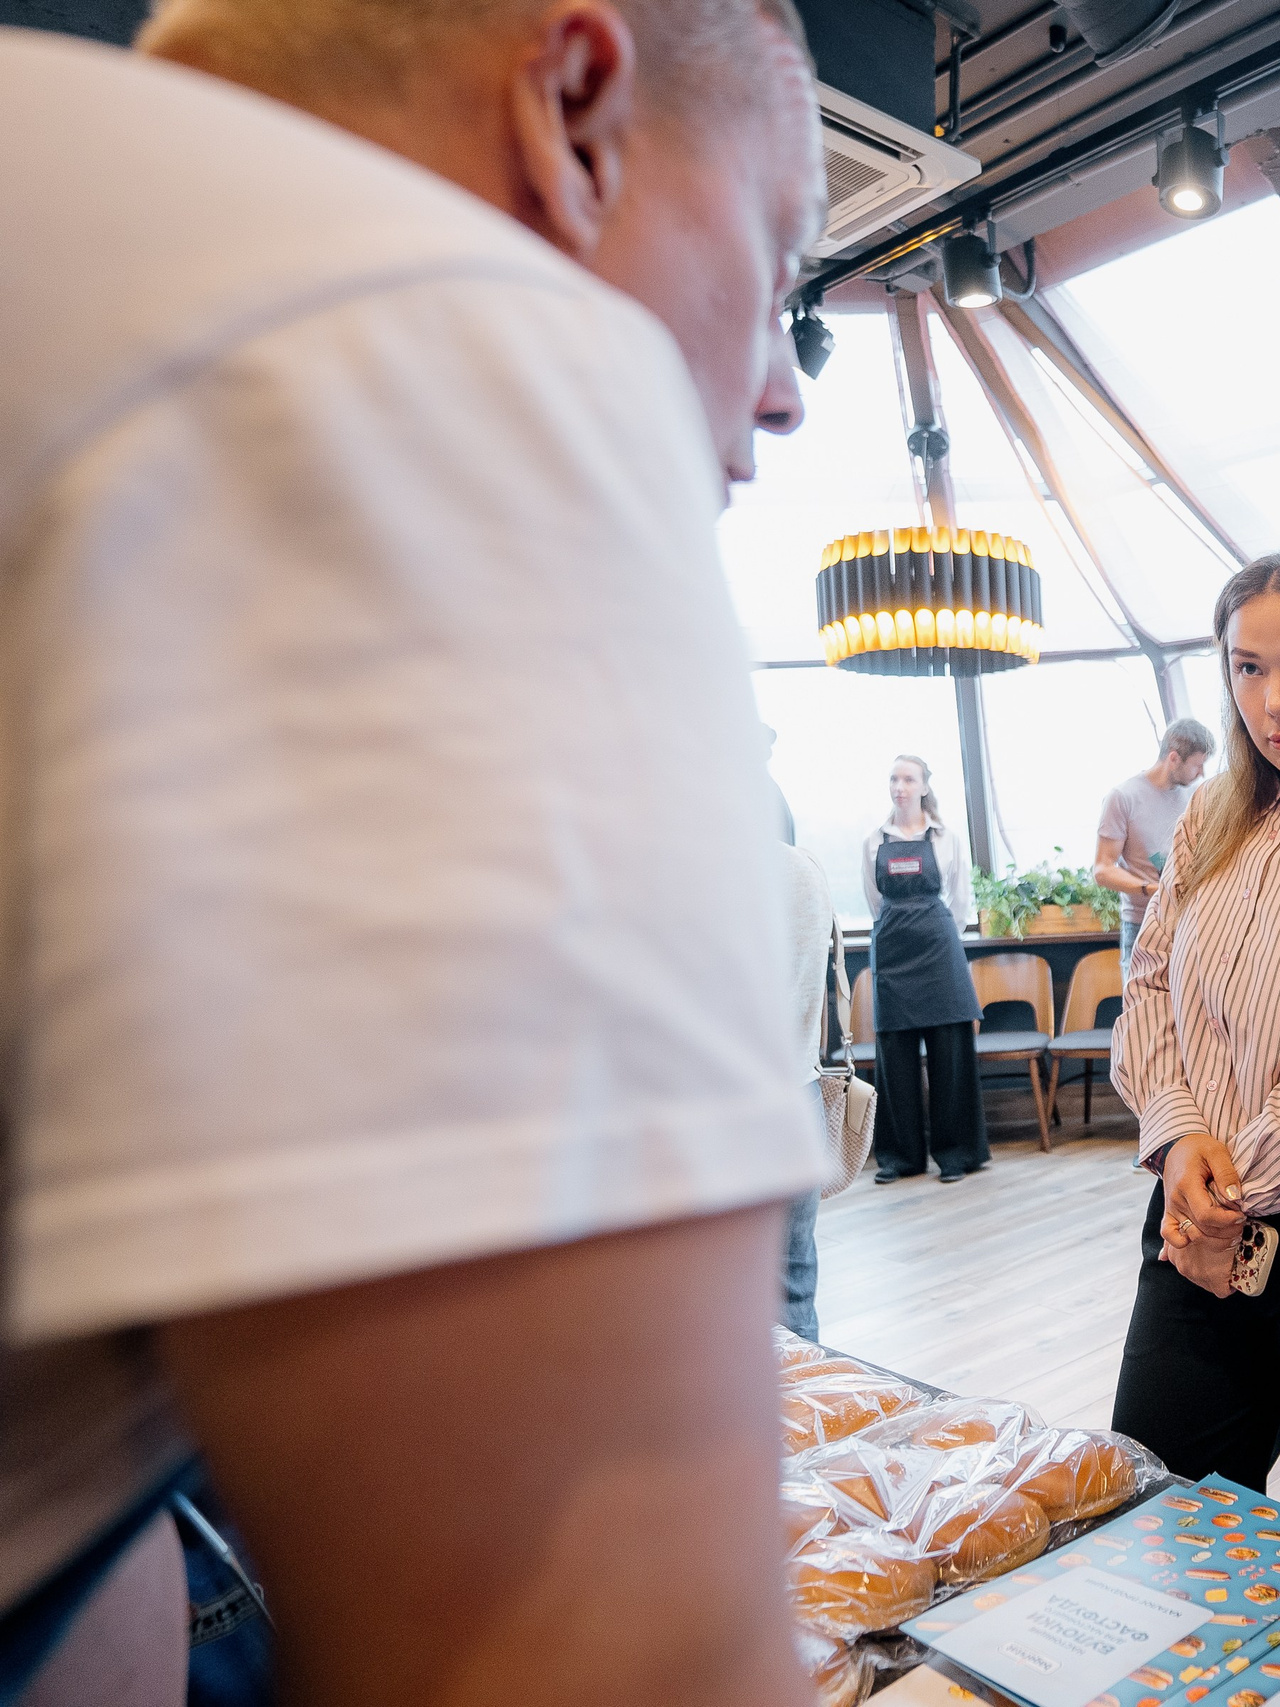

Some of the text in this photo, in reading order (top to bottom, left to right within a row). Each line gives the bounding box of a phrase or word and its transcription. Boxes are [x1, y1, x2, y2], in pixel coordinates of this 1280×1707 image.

[1047, 1594, 1150, 1643] ФАСТФУДА
[1141, 1600, 1183, 1619] КАТАЛОГ
[1026, 1611, 1117, 1656] БУЛОЧКИ
